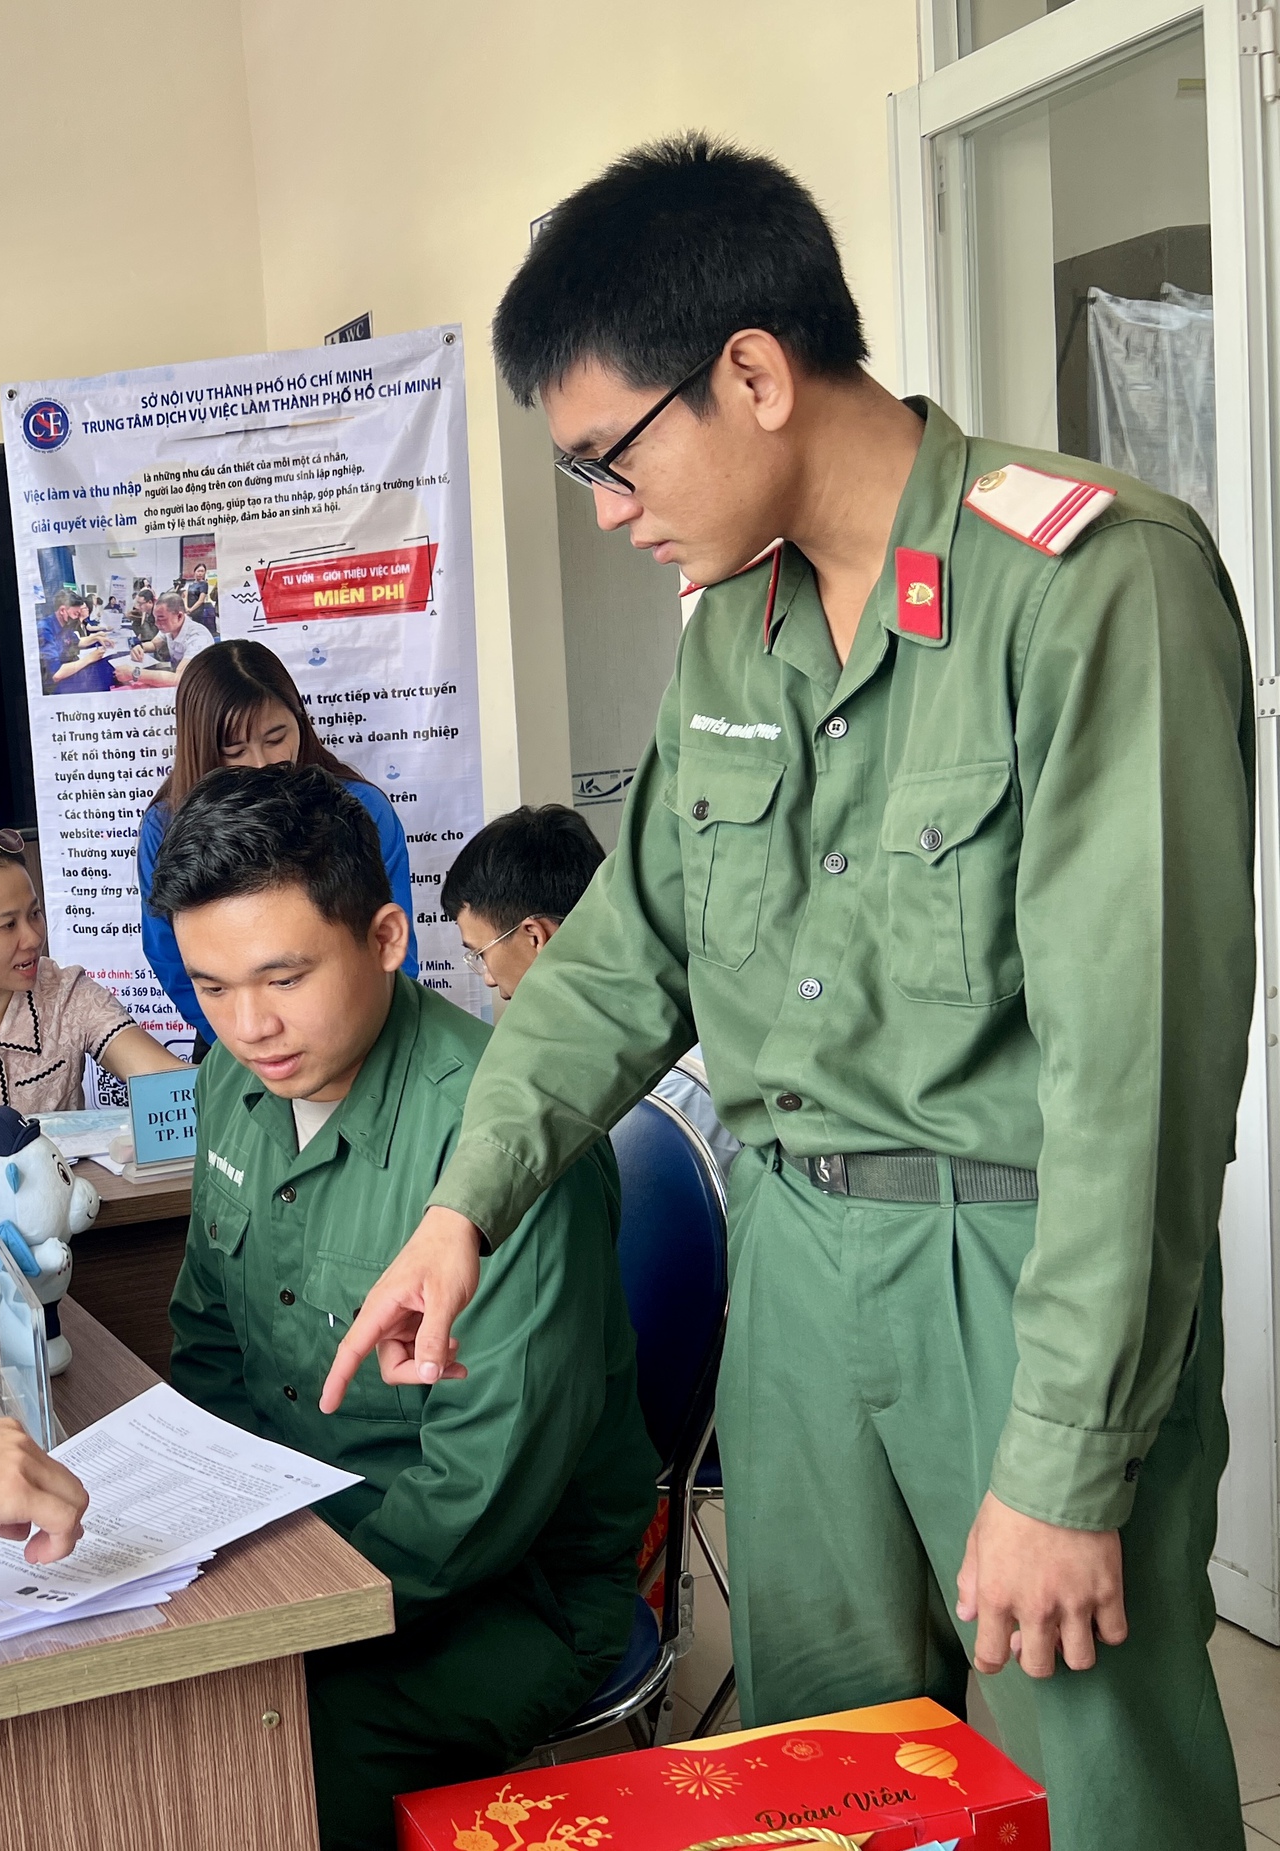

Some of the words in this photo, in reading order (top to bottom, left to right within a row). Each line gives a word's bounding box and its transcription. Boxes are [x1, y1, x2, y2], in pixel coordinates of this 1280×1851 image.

[346, 322, 365, 342] WC
[141, 392, 158, 409] SỞ
[161, 389, 184, 407] NỘI
[186, 389, 203, 405] VỤ
[208, 383, 253, 400] THÀNH
[256, 377, 283, 394] PHỐ
[311, 369, 332, 387] CHÍ
[336, 368, 372, 384] MINH
[82, 417, 124, 434] TRUNG
[126, 413, 153, 429] TÂM
[156, 410, 187, 426] DỊCH
[189, 407, 207, 424] VỤ
[209, 402, 238, 421] VIỆC
[241, 397, 270, 415] LÀM
[272, 392, 319, 411] THÀNH
[323, 386, 351, 404] PHỐ
[378, 381, 402, 398] CHÍ
[404, 377, 442, 394] MINH
[143, 472, 152, 484] là
[153, 470, 180, 483] những
[182, 468, 199, 479] nhu
[234, 460, 254, 472] thiết
[256, 459, 271, 471] của
[292, 455, 310, 467] một
[312, 454, 322, 464] cá
[324, 452, 349, 462] nhân,
[144, 486, 169, 499] người
[170, 484, 184, 495] lao
[185, 482, 206, 494] động
[208, 480, 226, 491] trên
[228, 478, 242, 488] con
[244, 474, 272, 488] đường
[274, 473, 294, 483] mưu
[296, 470, 314, 481] sinh
[316, 468, 330, 480] lập
[332, 465, 365, 478] nghiệp.
[24, 488, 46, 506] Việc
[47, 486, 70, 501] làm
[72, 485, 88, 499] và
[89, 484, 110, 498] thu
[112, 481, 142, 497] nhập
[144, 506, 158, 518] cho
[160, 504, 184, 516] người
[186, 502, 199, 514] lao
[200, 500, 225, 512] động,
[226, 496, 246, 510] giúp
[247, 494, 262, 506] tạo
[264, 496, 272, 505] ra
[274, 492, 290, 504] thu
[292, 490, 316, 503] nhập,
[318, 487, 334, 500] góp
[360, 482, 382, 494] tăng
[382, 478, 414, 492] trưởng
[416, 475, 436, 487] kinh
[31, 519, 51, 534] Giải
[53, 514, 87, 534] quyết
[89, 514, 113, 533] việc
[115, 512, 138, 527] làm
[144, 520, 166, 534] giảm
[178, 516, 186, 528] lệ
[186, 514, 206, 528] thất
[208, 512, 240, 526] nghiệp,
[241, 510, 260, 522] đảm
[261, 508, 278, 520] bảo
[279, 508, 290, 518] an
[292, 504, 310, 516] sinh
[324, 501, 341, 514] hội.
[343, 568, 367, 580] THIỆU
[370, 564, 388, 578] VIỆC
[314, 582, 365, 607] MIỄN
[372, 580, 405, 602] PHÍ
[56, 710, 96, 724] Thường
[98, 708, 131, 722] xuyên
[134, 704, 147, 718] tổ
[317, 693, 342, 707] trực
[344, 688, 370, 705] tiếp
[373, 688, 388, 700] và
[392, 687, 417, 701] trực
[419, 681, 457, 698] tuyến
[52, 732, 67, 746] tại
[69, 730, 99, 744] Trung
[101, 728, 124, 740] tâm
[126, 727, 140, 739] và
[142, 726, 161, 738] các
[318, 711, 367, 728] nghiệp.
[60, 748, 79, 762] Kết
[82, 748, 99, 762] nối
[102, 748, 136, 762] thông
[140, 746, 158, 758] tin
[318, 734, 344, 748] việc
[348, 732, 363, 744] và
[368, 729, 408, 742] doanh
[412, 726, 459, 742] nghiệp
[54, 768, 85, 784] tuyển
[88, 770, 116, 784] dụng
[117, 768, 133, 782] tại
[135, 766, 154, 778] các
[56, 789, 74, 802] các
[75, 789, 106, 803] phiên
[108, 788, 127, 800] sàn
[128, 787, 154, 802] giao
[388, 791, 418, 804] trên
[64, 808, 82, 820] Các
[84, 808, 116, 822] thông
[118, 808, 134, 820] tin
[60, 828, 105, 840] website:
[406, 830, 438, 844] nước
[441, 829, 464, 842] cho
[68, 846, 108, 860] Thường
[62, 867, 79, 878] lao
[81, 866, 112, 880] động.
[410, 872, 442, 887] dụng
[70, 886, 98, 899] Cung
[101, 885, 123, 899] ứng
[126, 884, 140, 896] và
[65, 904, 96, 918] động.
[416, 911, 438, 927] đại
[72, 924, 99, 938] Cung
[100, 922, 120, 937] cấp
[108, 968, 134, 980] chính:
[134, 968, 146, 980] Số
[426, 960, 455, 972] Minh.
[121, 985, 131, 997] số
[132, 986, 148, 998] 369
[424, 978, 452, 990] Minh.
[134, 1004, 150, 1014] 764
[152, 1003, 173, 1014] Cách
[166, 1019, 184, 1032] tiếp
[148, 1107, 187, 1127] DỊCH
[154, 1128, 179, 1142] TP.
[755, 1804, 842, 1830] Đoàn
[842, 1786, 916, 1812] Viên
